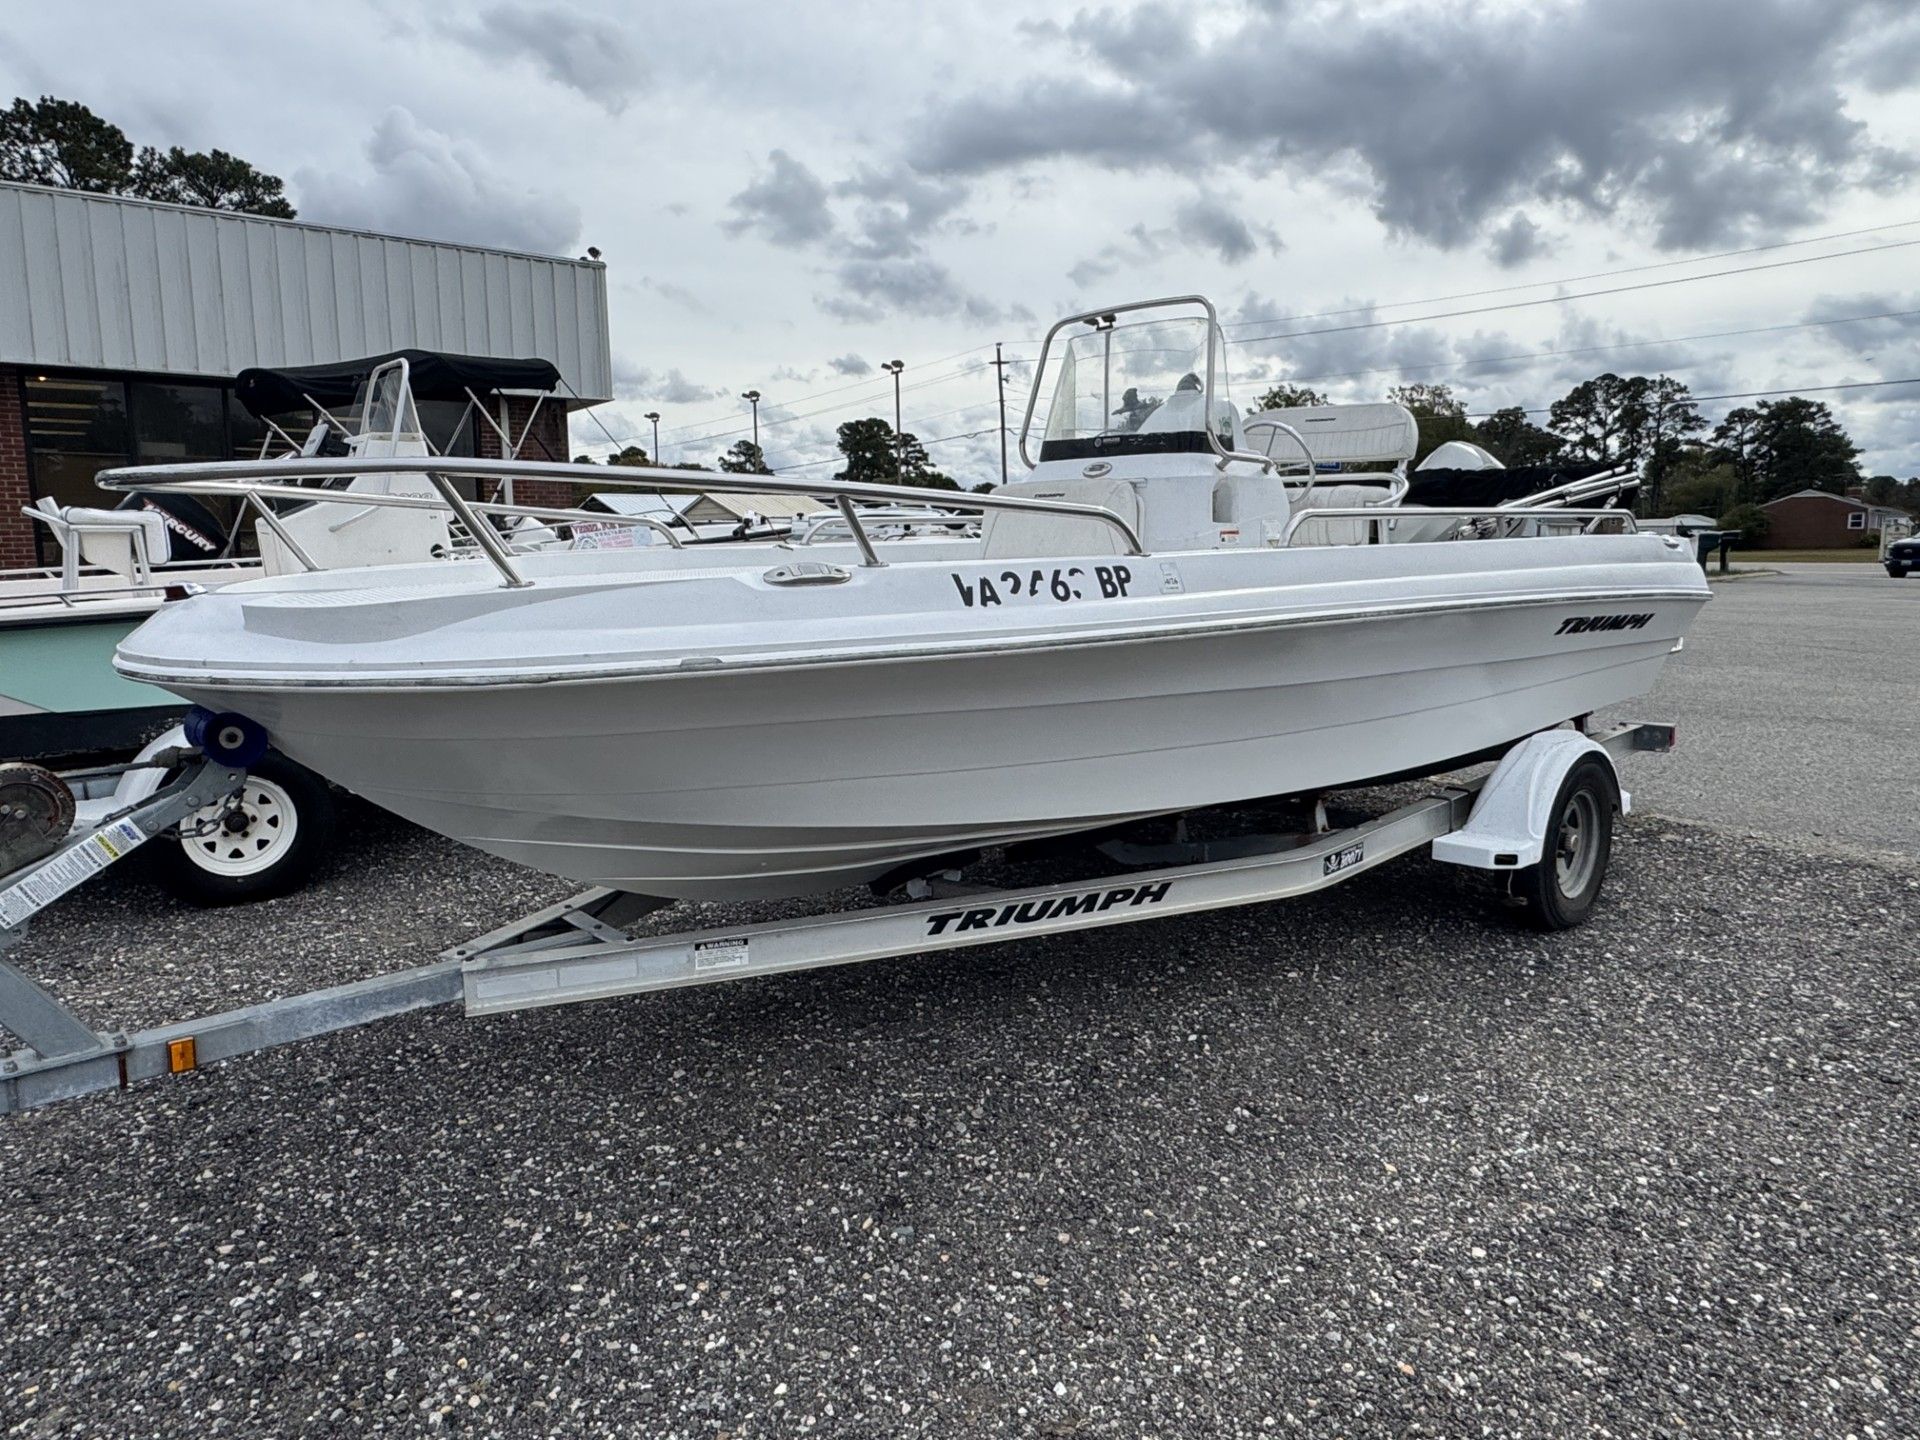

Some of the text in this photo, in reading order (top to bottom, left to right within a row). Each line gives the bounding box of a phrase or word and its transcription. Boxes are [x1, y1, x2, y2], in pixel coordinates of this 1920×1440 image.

[1094, 565, 1132, 598] BP
[1553, 612, 1656, 636] TRIUMPH
[927, 882, 1173, 936] TRIUMPH
